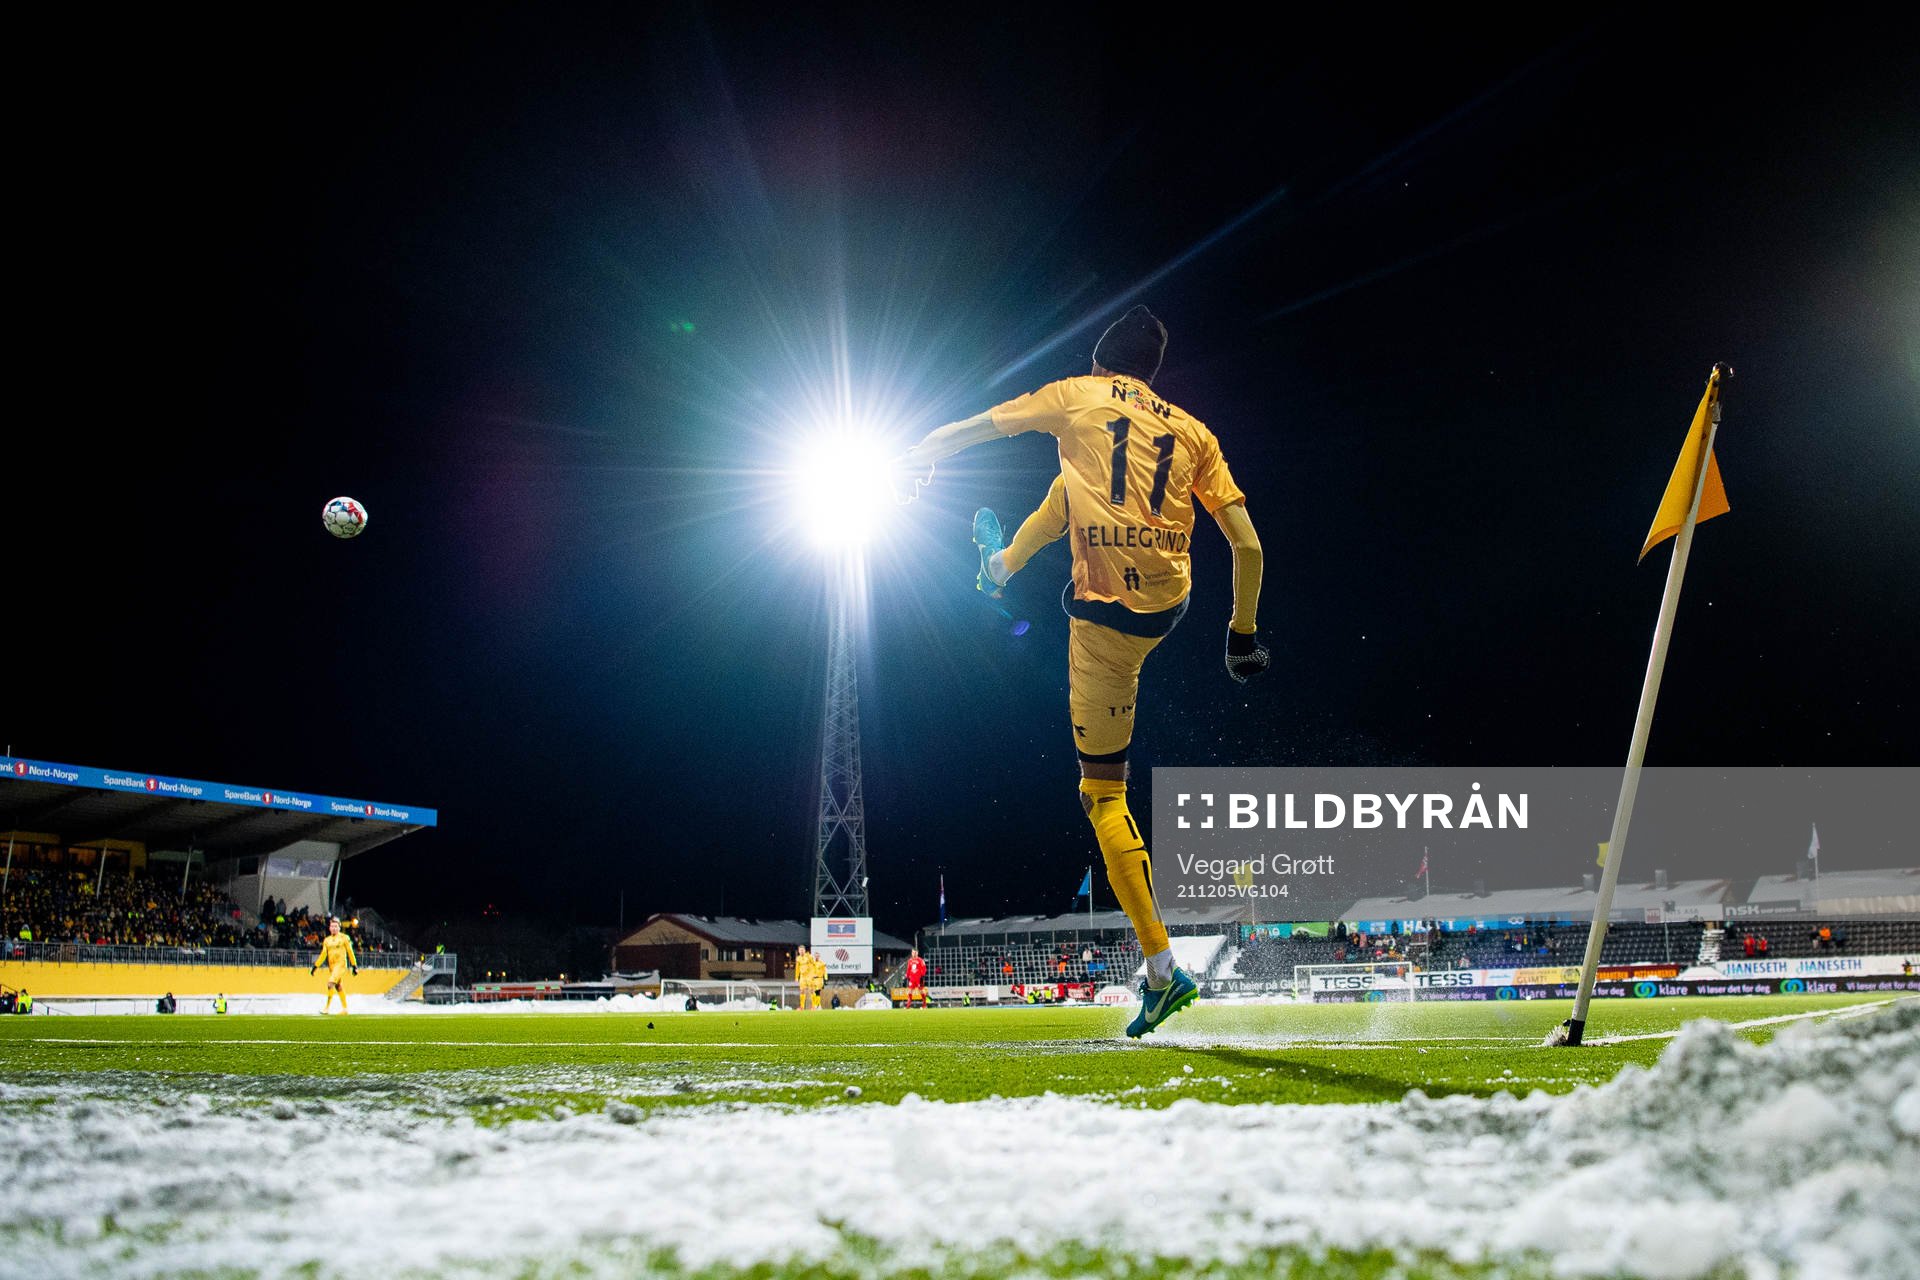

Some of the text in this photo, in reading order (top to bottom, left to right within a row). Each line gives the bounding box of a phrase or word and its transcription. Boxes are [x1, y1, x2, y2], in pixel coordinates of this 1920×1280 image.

[1106, 416, 1175, 518] 11
[28, 765, 79, 781] Nord-Norge
[103, 774, 146, 789] SpareBank
[158, 782, 203, 796] Nord-Norge
[224, 789, 262, 802] SpareBank
[273, 795, 312, 808] Nord-Norge
[331, 802, 364, 814] SpareBank
[374, 807, 409, 819] Nord-Norge
[1320, 976, 1375, 989] TESS
[1415, 973, 1473, 987] TESS
[1807, 981, 1838, 993] klare
[1519, 987, 1547, 999] klare
[1659, 983, 1689, 996] klare
